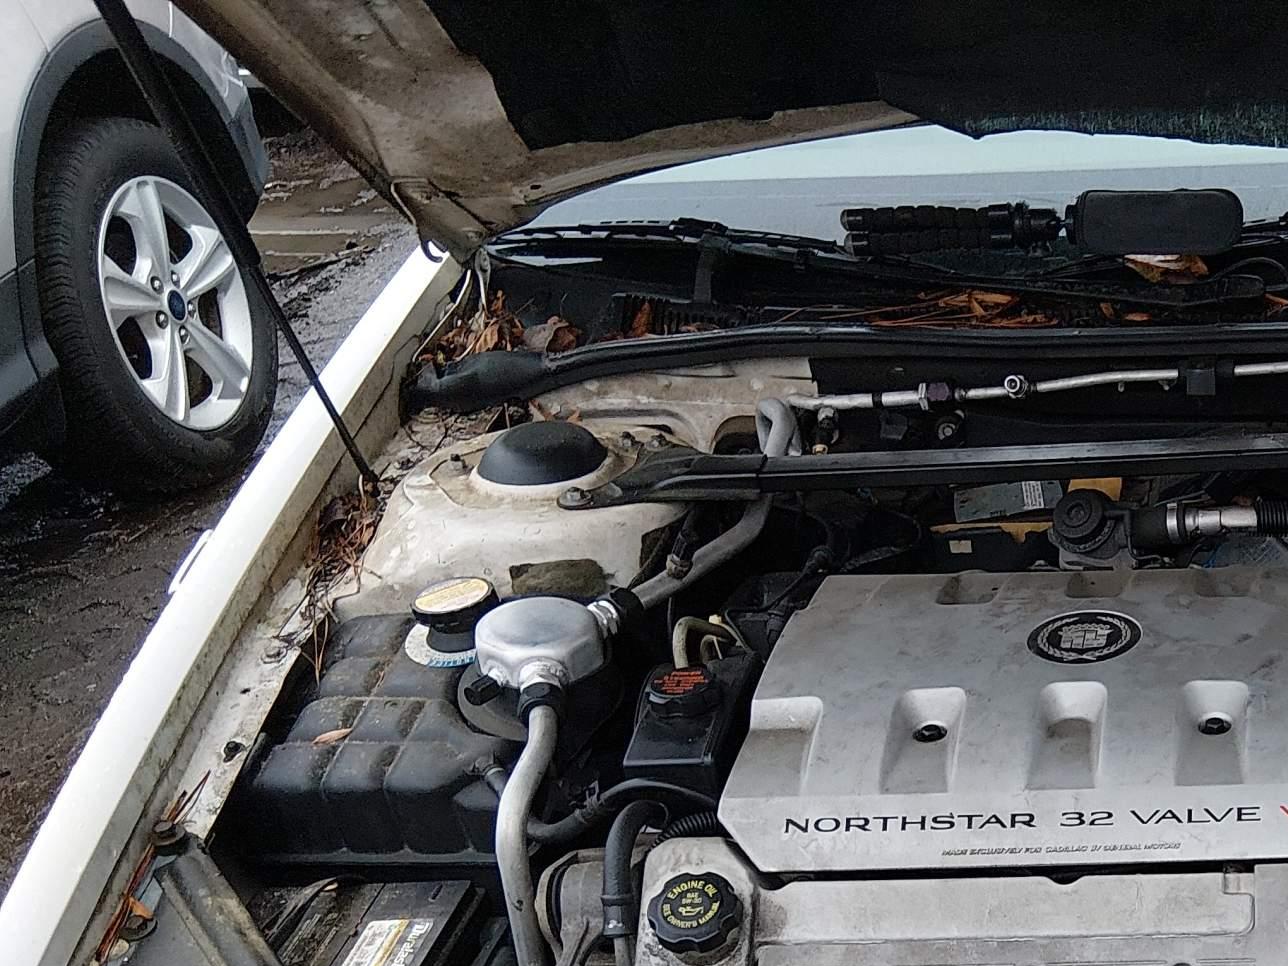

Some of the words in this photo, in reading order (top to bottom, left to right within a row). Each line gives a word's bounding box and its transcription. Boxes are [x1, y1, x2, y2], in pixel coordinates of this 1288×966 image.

[783, 811, 1037, 834] NORTHSTAR
[1059, 810, 1115, 828] 32
[1130, 805, 1262, 826] VALVE
[667, 880, 705, 899] ENGINE
[704, 884, 718, 898] OIL
